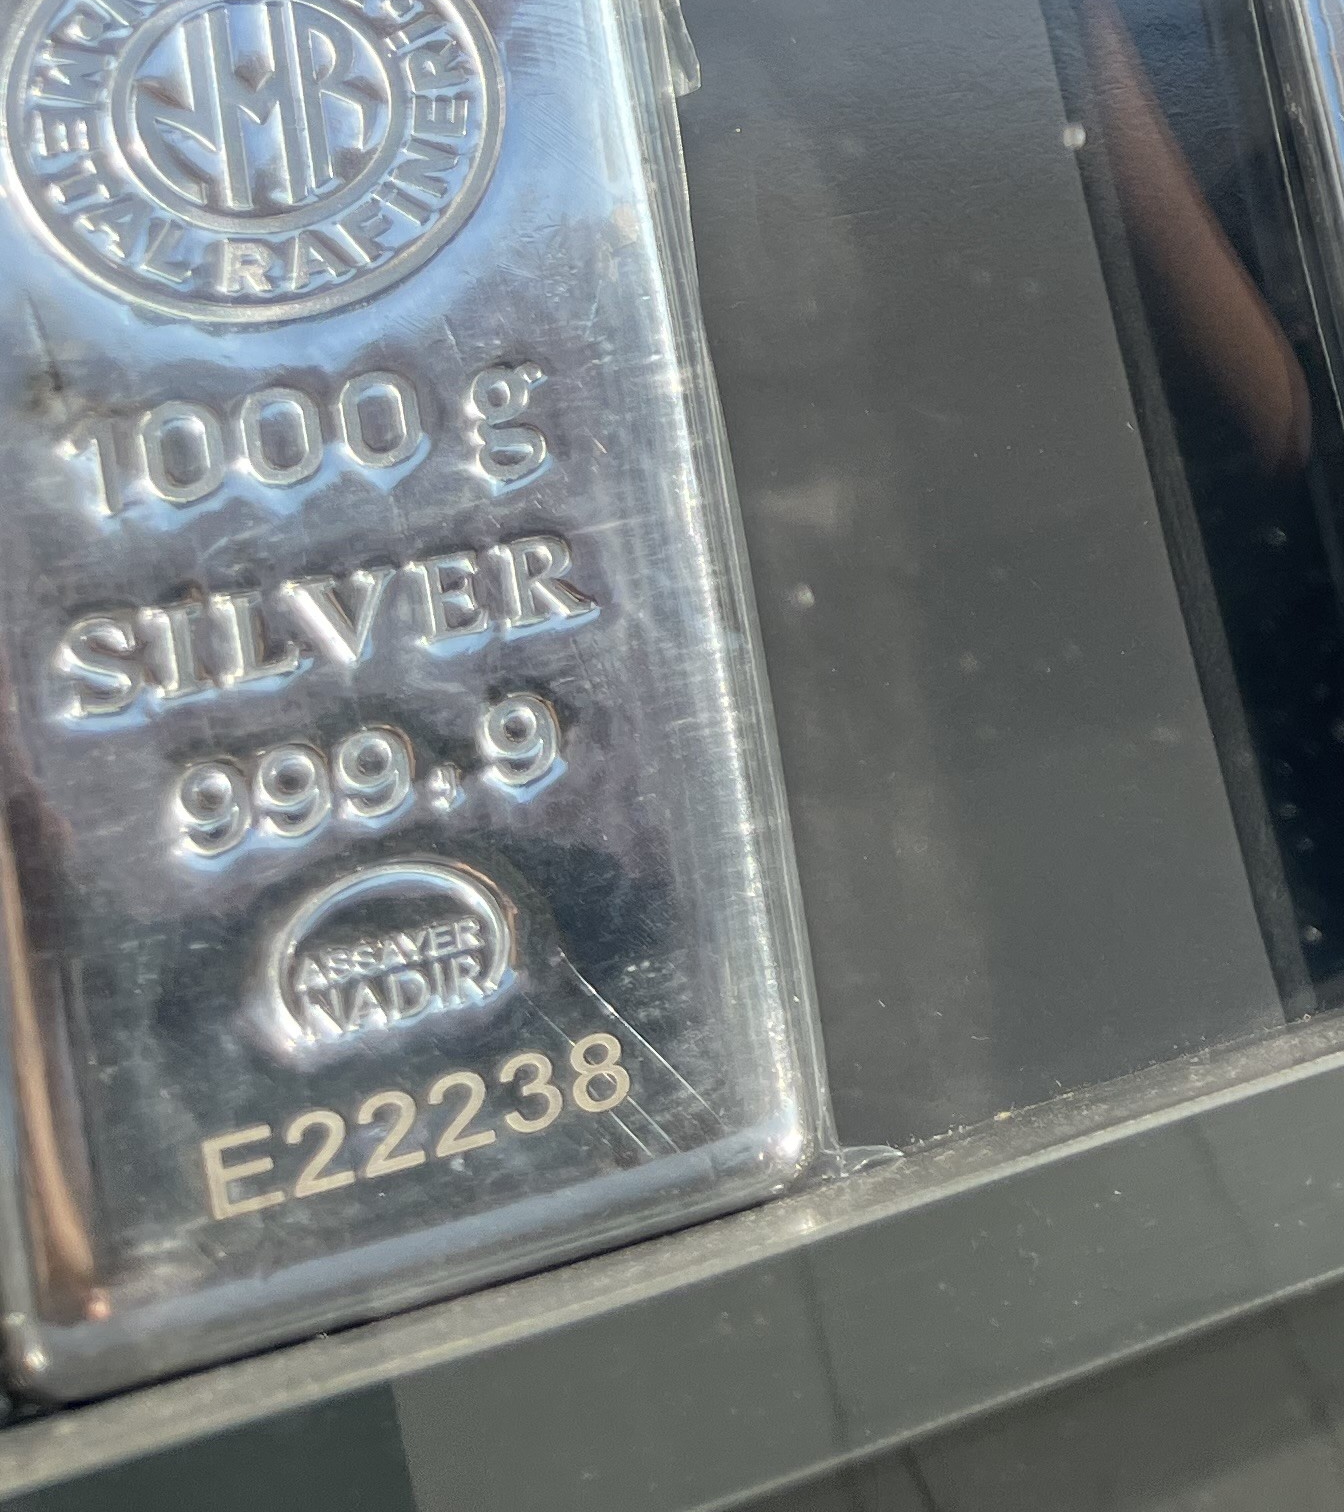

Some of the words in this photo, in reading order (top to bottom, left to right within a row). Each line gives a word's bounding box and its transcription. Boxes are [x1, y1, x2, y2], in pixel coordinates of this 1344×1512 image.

[57, 368, 432, 520] 1000
[467, 361, 551, 494] g
[53, 533, 601, 729] SILVER
[296, 916, 486, 994] ASSAYER
[202, 1033, 632, 1221] E22238
